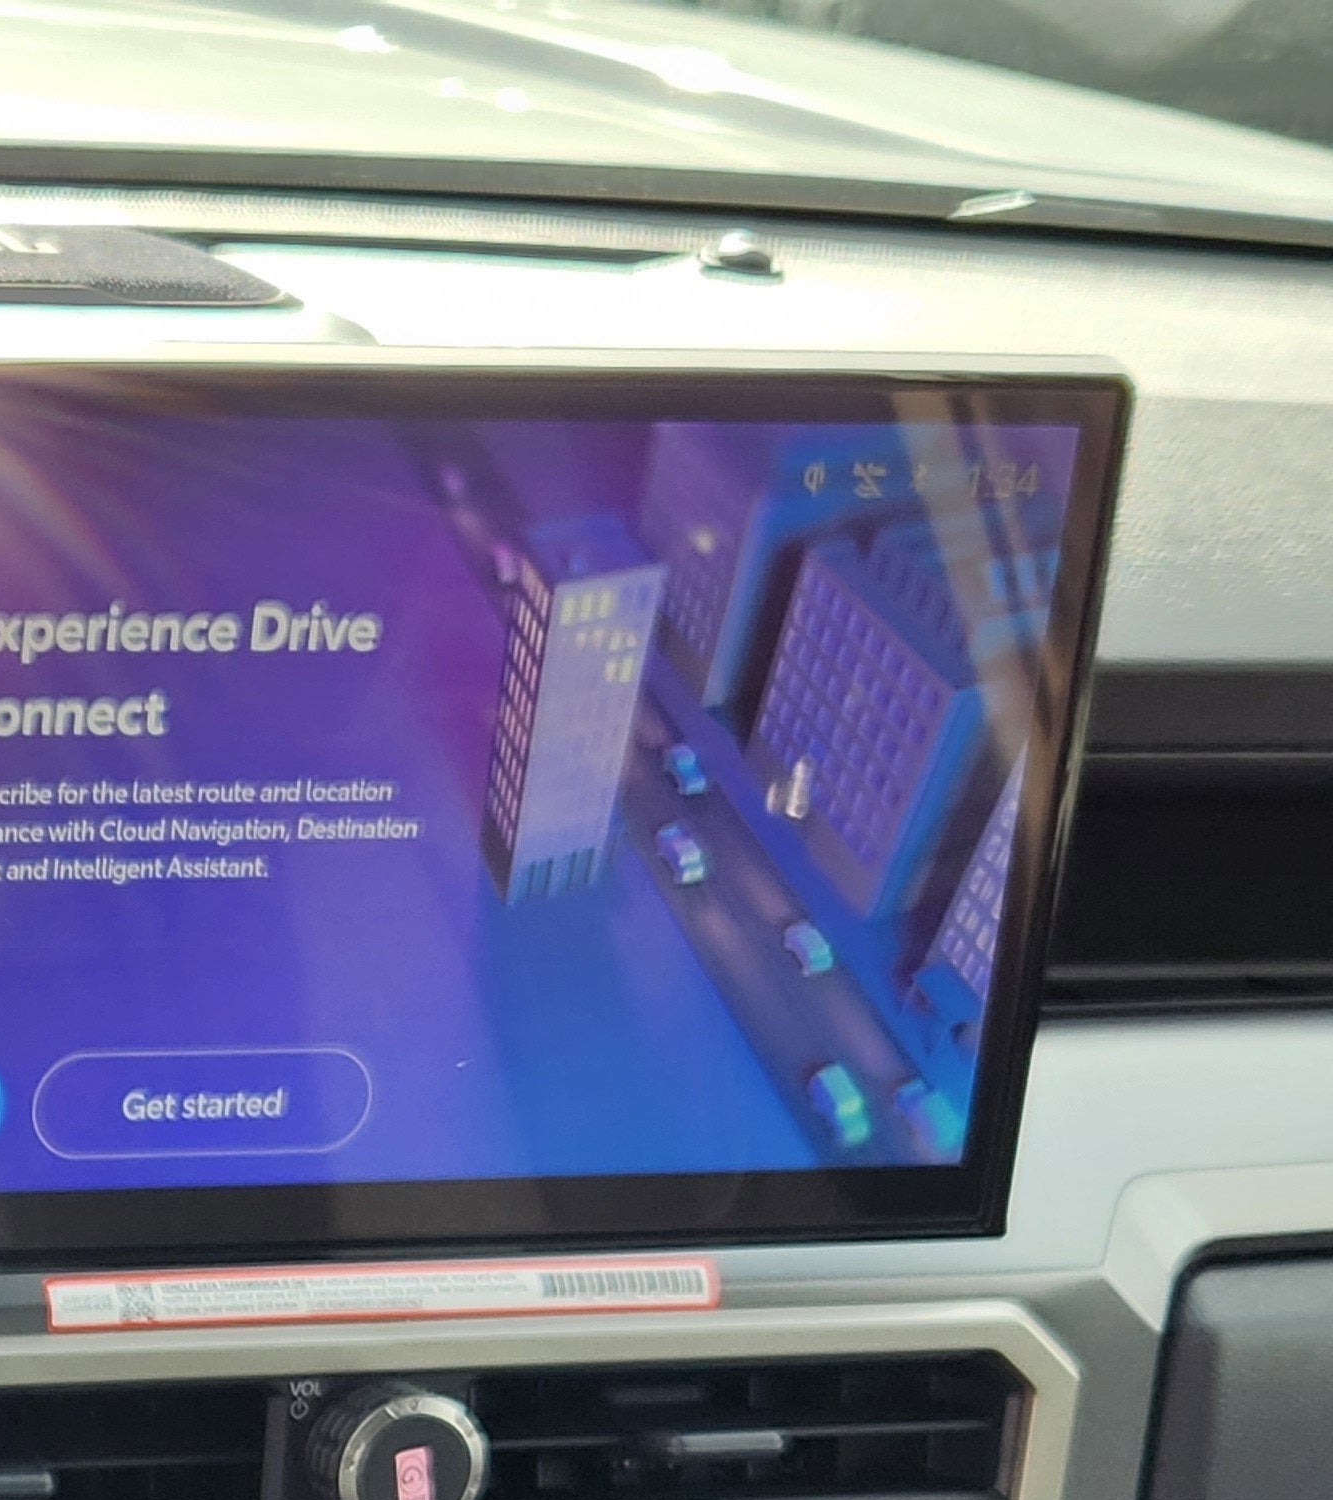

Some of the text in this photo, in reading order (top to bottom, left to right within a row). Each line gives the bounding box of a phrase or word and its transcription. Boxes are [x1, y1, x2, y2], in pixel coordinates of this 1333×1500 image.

[250, 604, 379, 652] Drive
[57, 781, 88, 804] for
[92, 781, 128, 804] the
[132, 781, 193, 804] latest
[198, 783, 254, 803] route
[260, 779, 301, 803] and
[306, 779, 393, 802] location
[48, 820, 95, 843] with
[100, 820, 165, 843] Cloud
[170, 819, 291, 846] Navigation,
[296, 817, 419, 841] Destination
[6, 858, 48, 881] and
[53, 857, 164, 885] Intelligent
[166, 856, 269, 880] Assistant.
[122, 1088, 284, 1121] Get started
[289, 1381, 322, 1397] VOL
